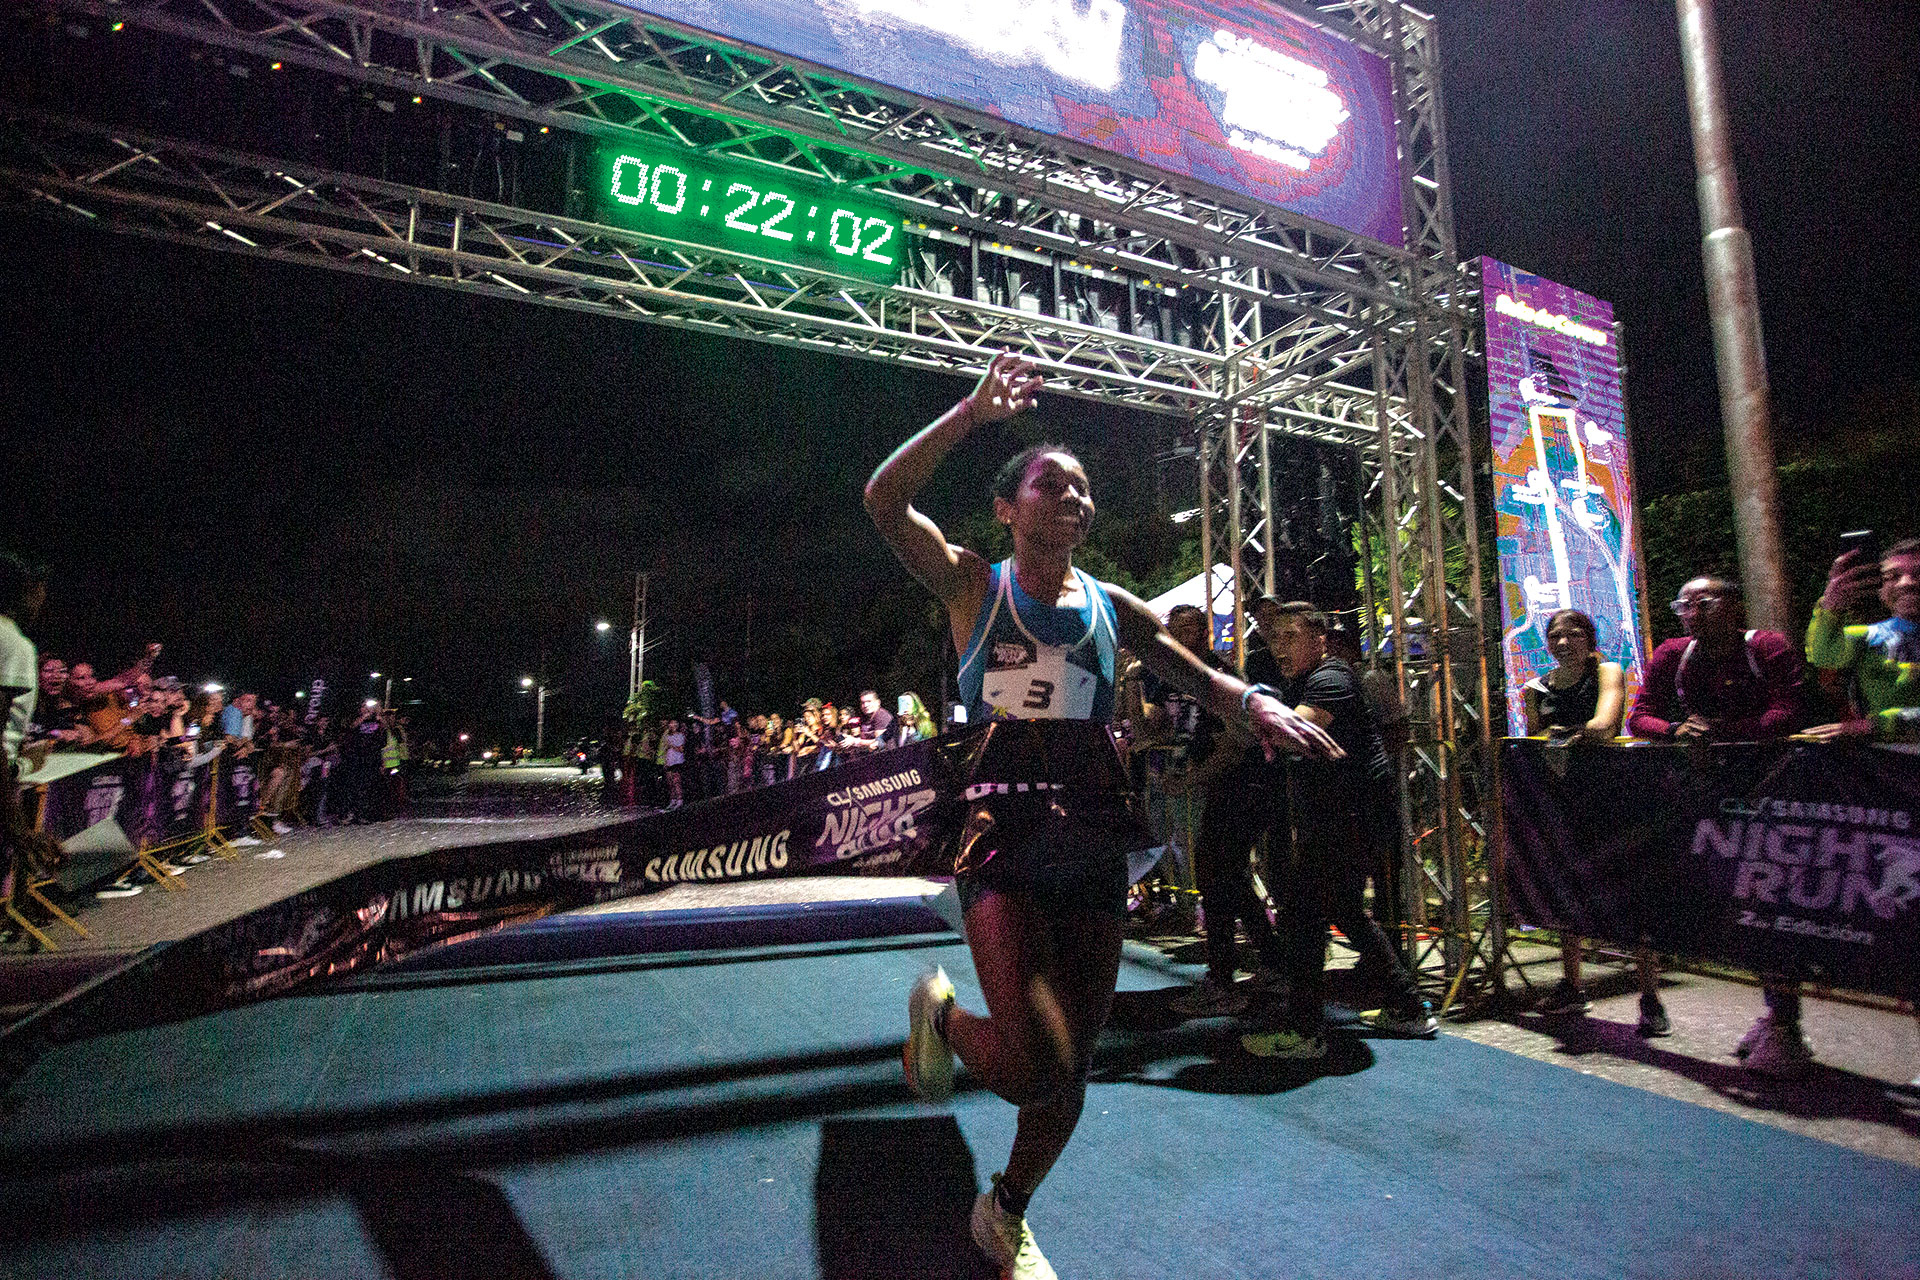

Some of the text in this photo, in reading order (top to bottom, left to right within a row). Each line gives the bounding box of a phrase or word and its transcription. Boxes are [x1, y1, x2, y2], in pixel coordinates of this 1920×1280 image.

[609, 154, 895, 265] 00:22:02
[1022, 679, 1055, 709] 3
[853, 769, 922, 800] SAMSUNG
[645, 830, 791, 882] SAMSUNG
